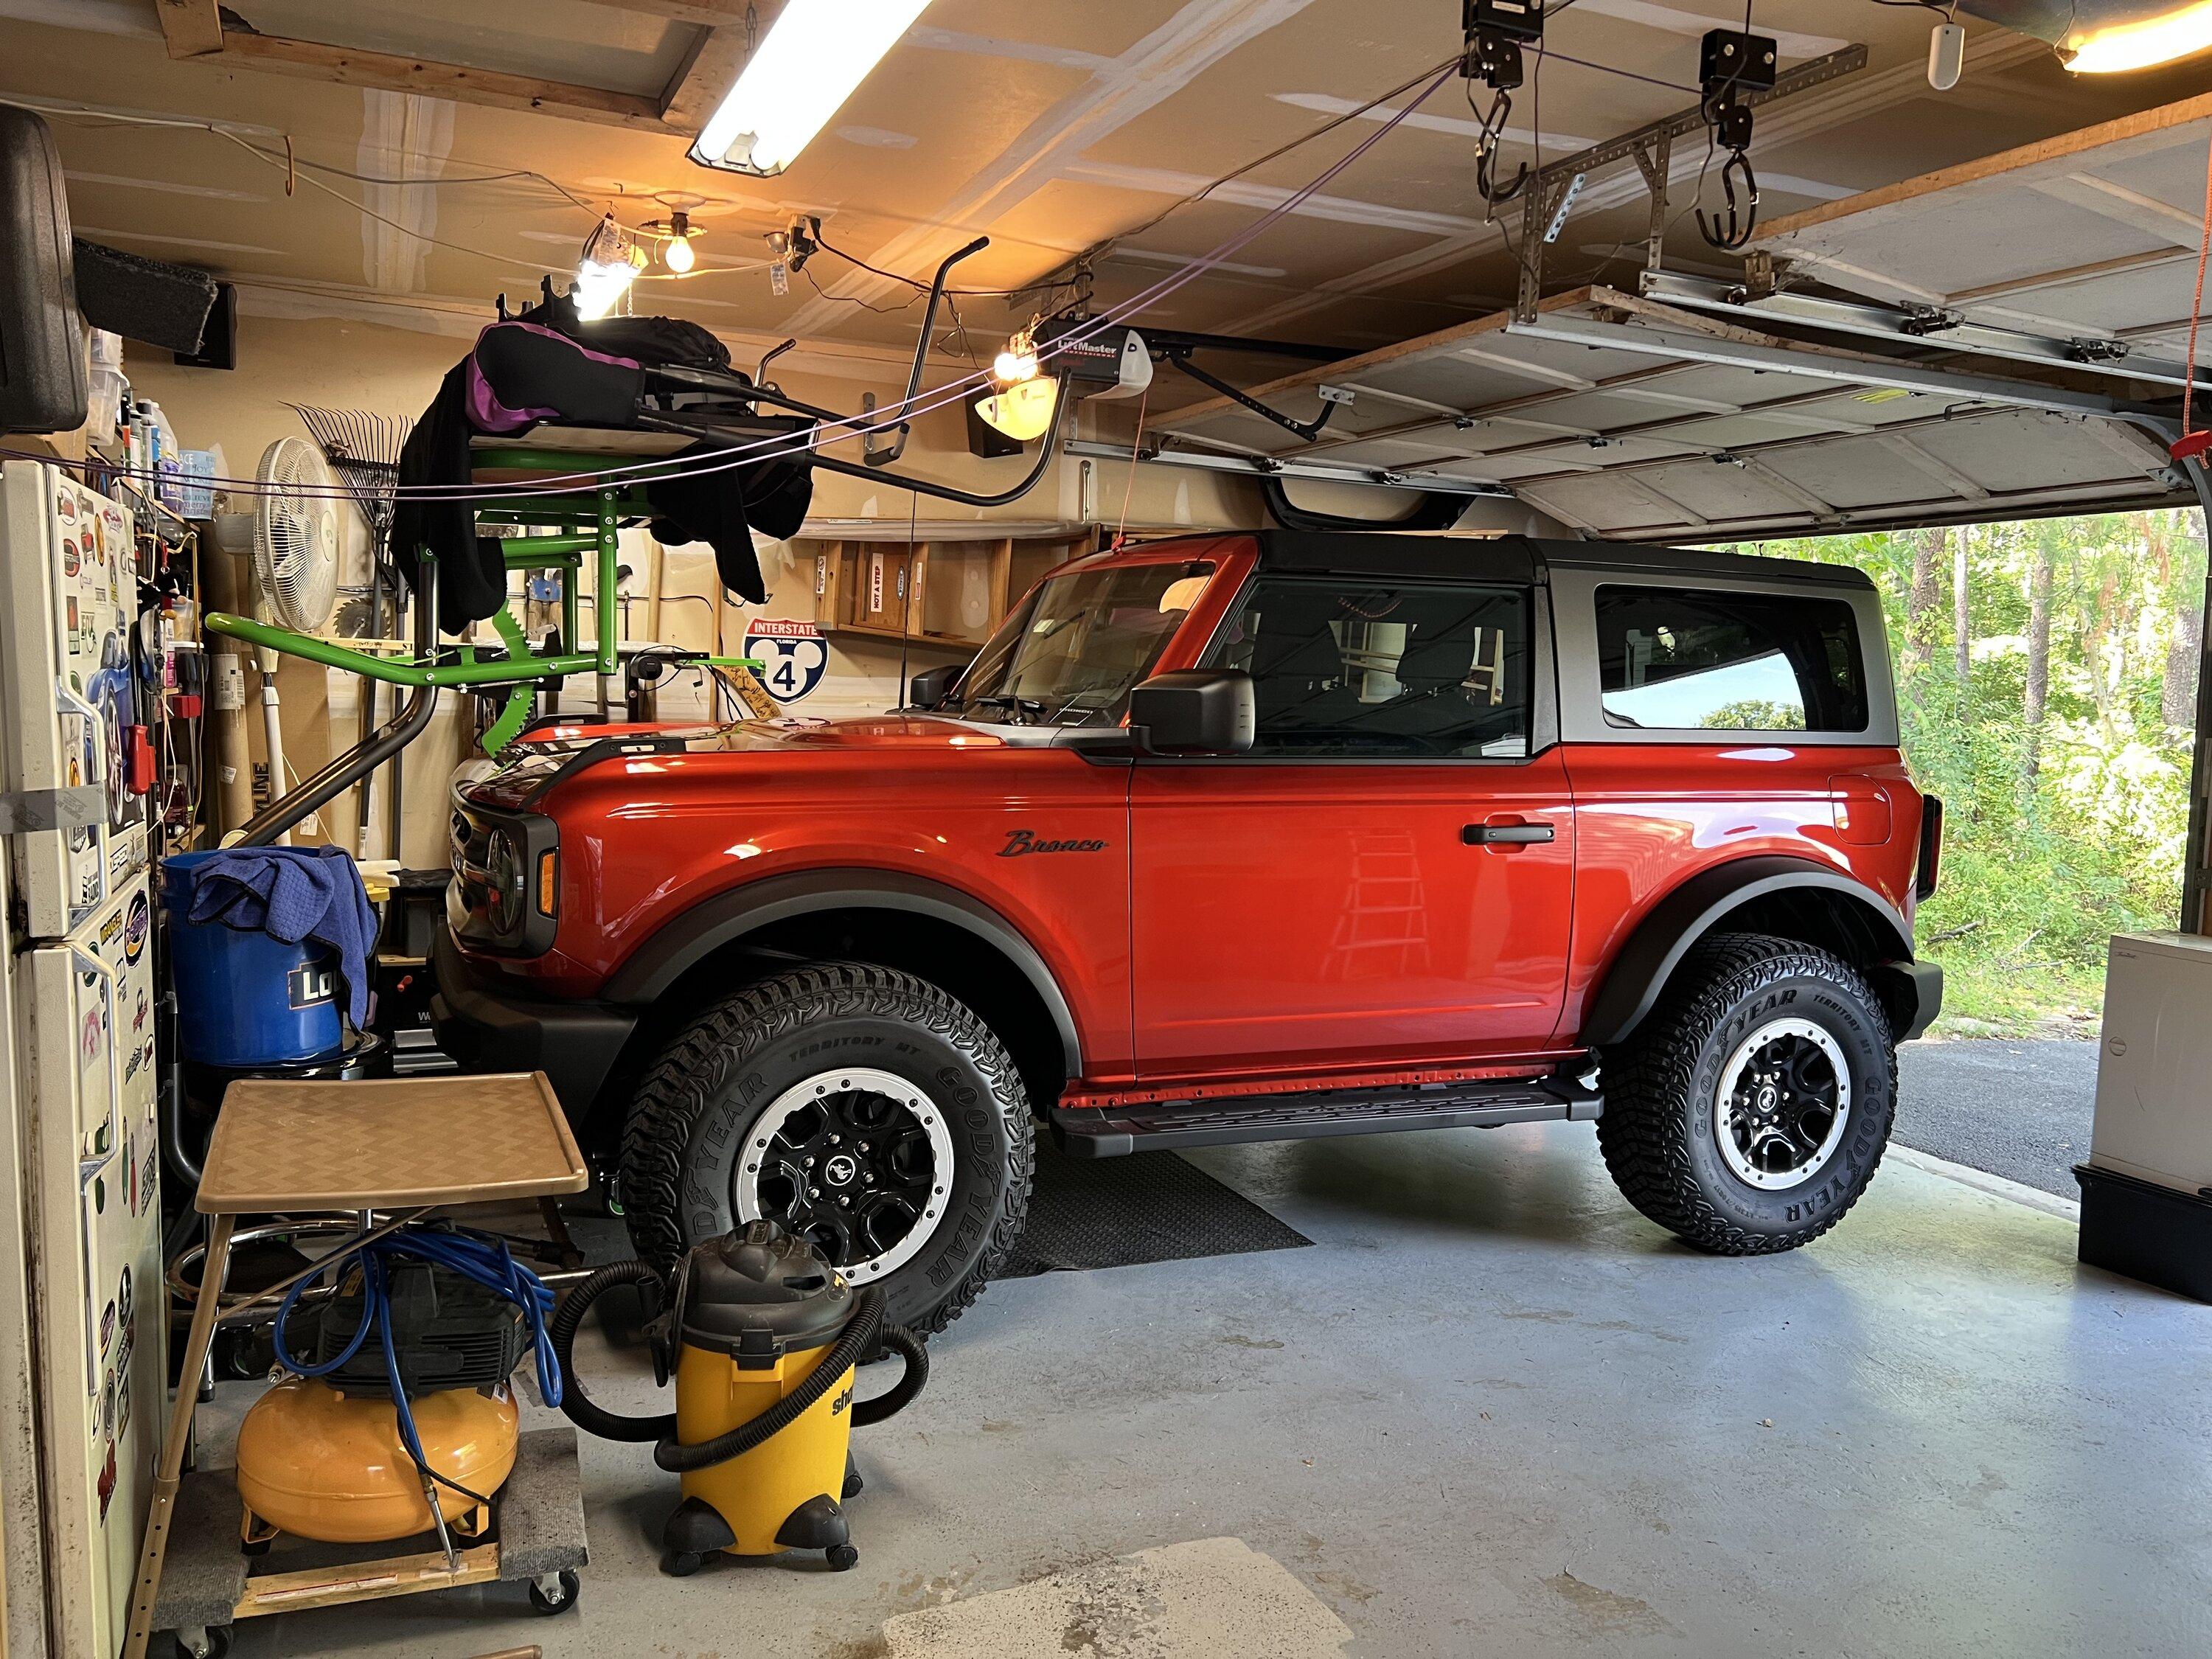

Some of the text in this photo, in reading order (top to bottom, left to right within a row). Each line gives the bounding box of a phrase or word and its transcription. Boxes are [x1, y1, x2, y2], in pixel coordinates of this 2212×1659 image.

[1057, 340, 1117, 355] LiftMaster
[754, 622, 818, 636] INTERSTATE
[773, 661, 796, 692] 4
[996, 830, 1110, 858] Bronco
[1813, 994, 1863, 1032] TERRITORY
[788, 1035, 885, 1062] TERRITORY
